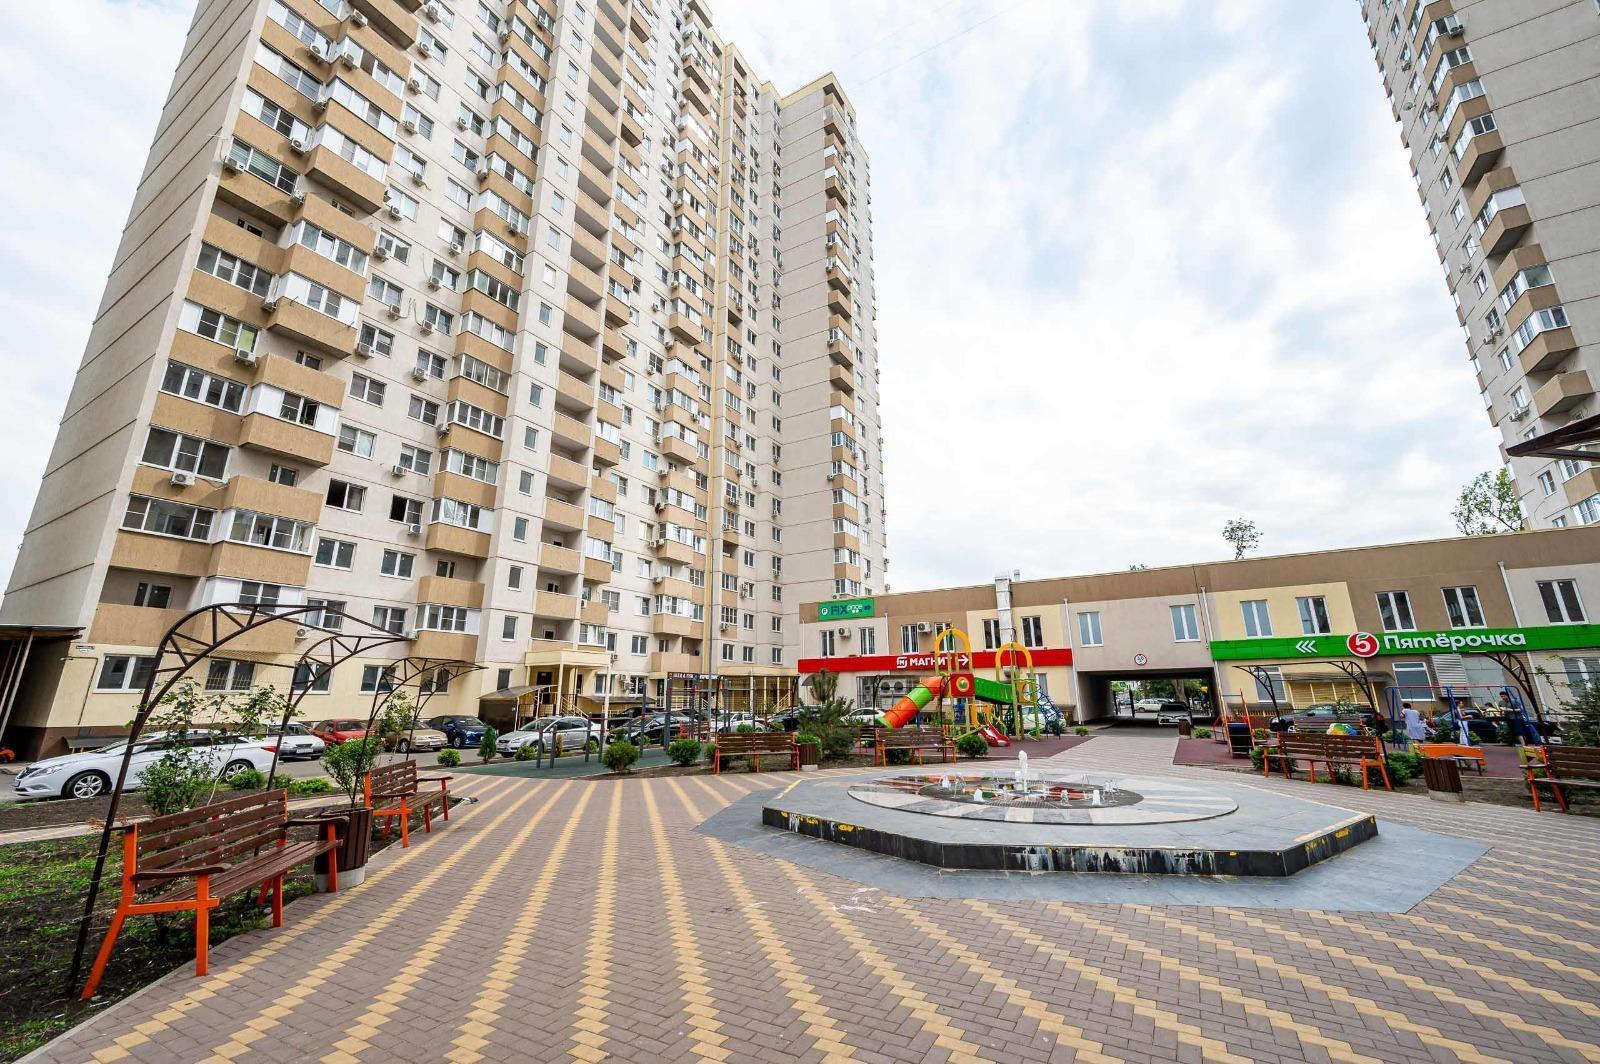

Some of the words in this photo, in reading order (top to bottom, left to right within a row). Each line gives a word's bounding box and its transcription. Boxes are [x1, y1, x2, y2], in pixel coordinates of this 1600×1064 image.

[831, 604, 848, 615] FIX
[1356, 632, 1371, 652] 5
[1384, 633, 1526, 651] Пятёрочка
